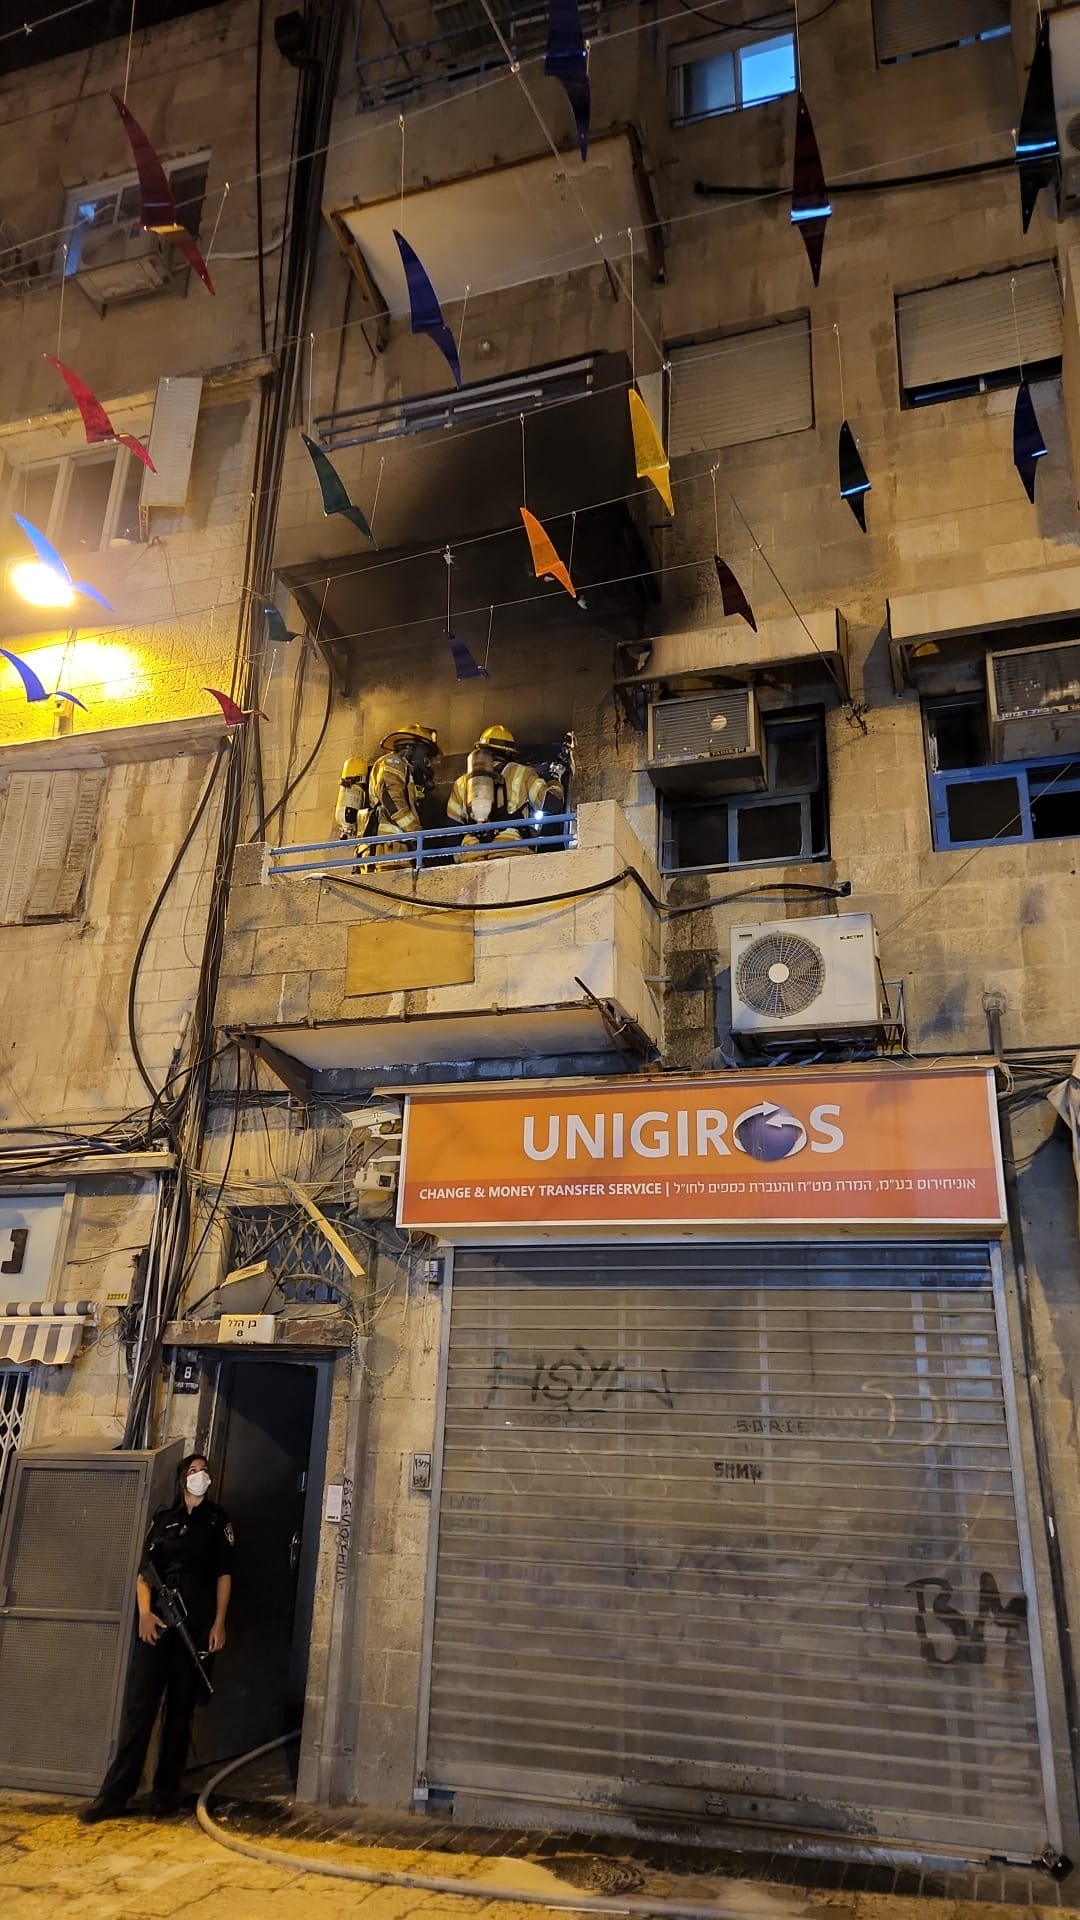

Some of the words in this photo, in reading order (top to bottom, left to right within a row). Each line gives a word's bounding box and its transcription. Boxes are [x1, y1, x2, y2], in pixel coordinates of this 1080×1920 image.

[673, 1181, 705, 1195] לחו"ל
[708, 1182, 745, 1194] כספים
[748, 1181, 794, 1193] והעברת
[797, 1180, 832, 1192] מט"ח
[835, 1180, 872, 1192] המרת
[917, 1178, 976, 1190] אוניחירוס
[419, 1186, 471, 1200] CHANGE
[474, 1186, 485, 1198] &
[488, 1185, 535, 1198] MONEY
[538, 1184, 605, 1197] TRANSFER
[608, 1182, 662, 1196] SERVICE
[228, 1319, 245, 1328] הלל
[183, 1366, 193, 1380] 8
